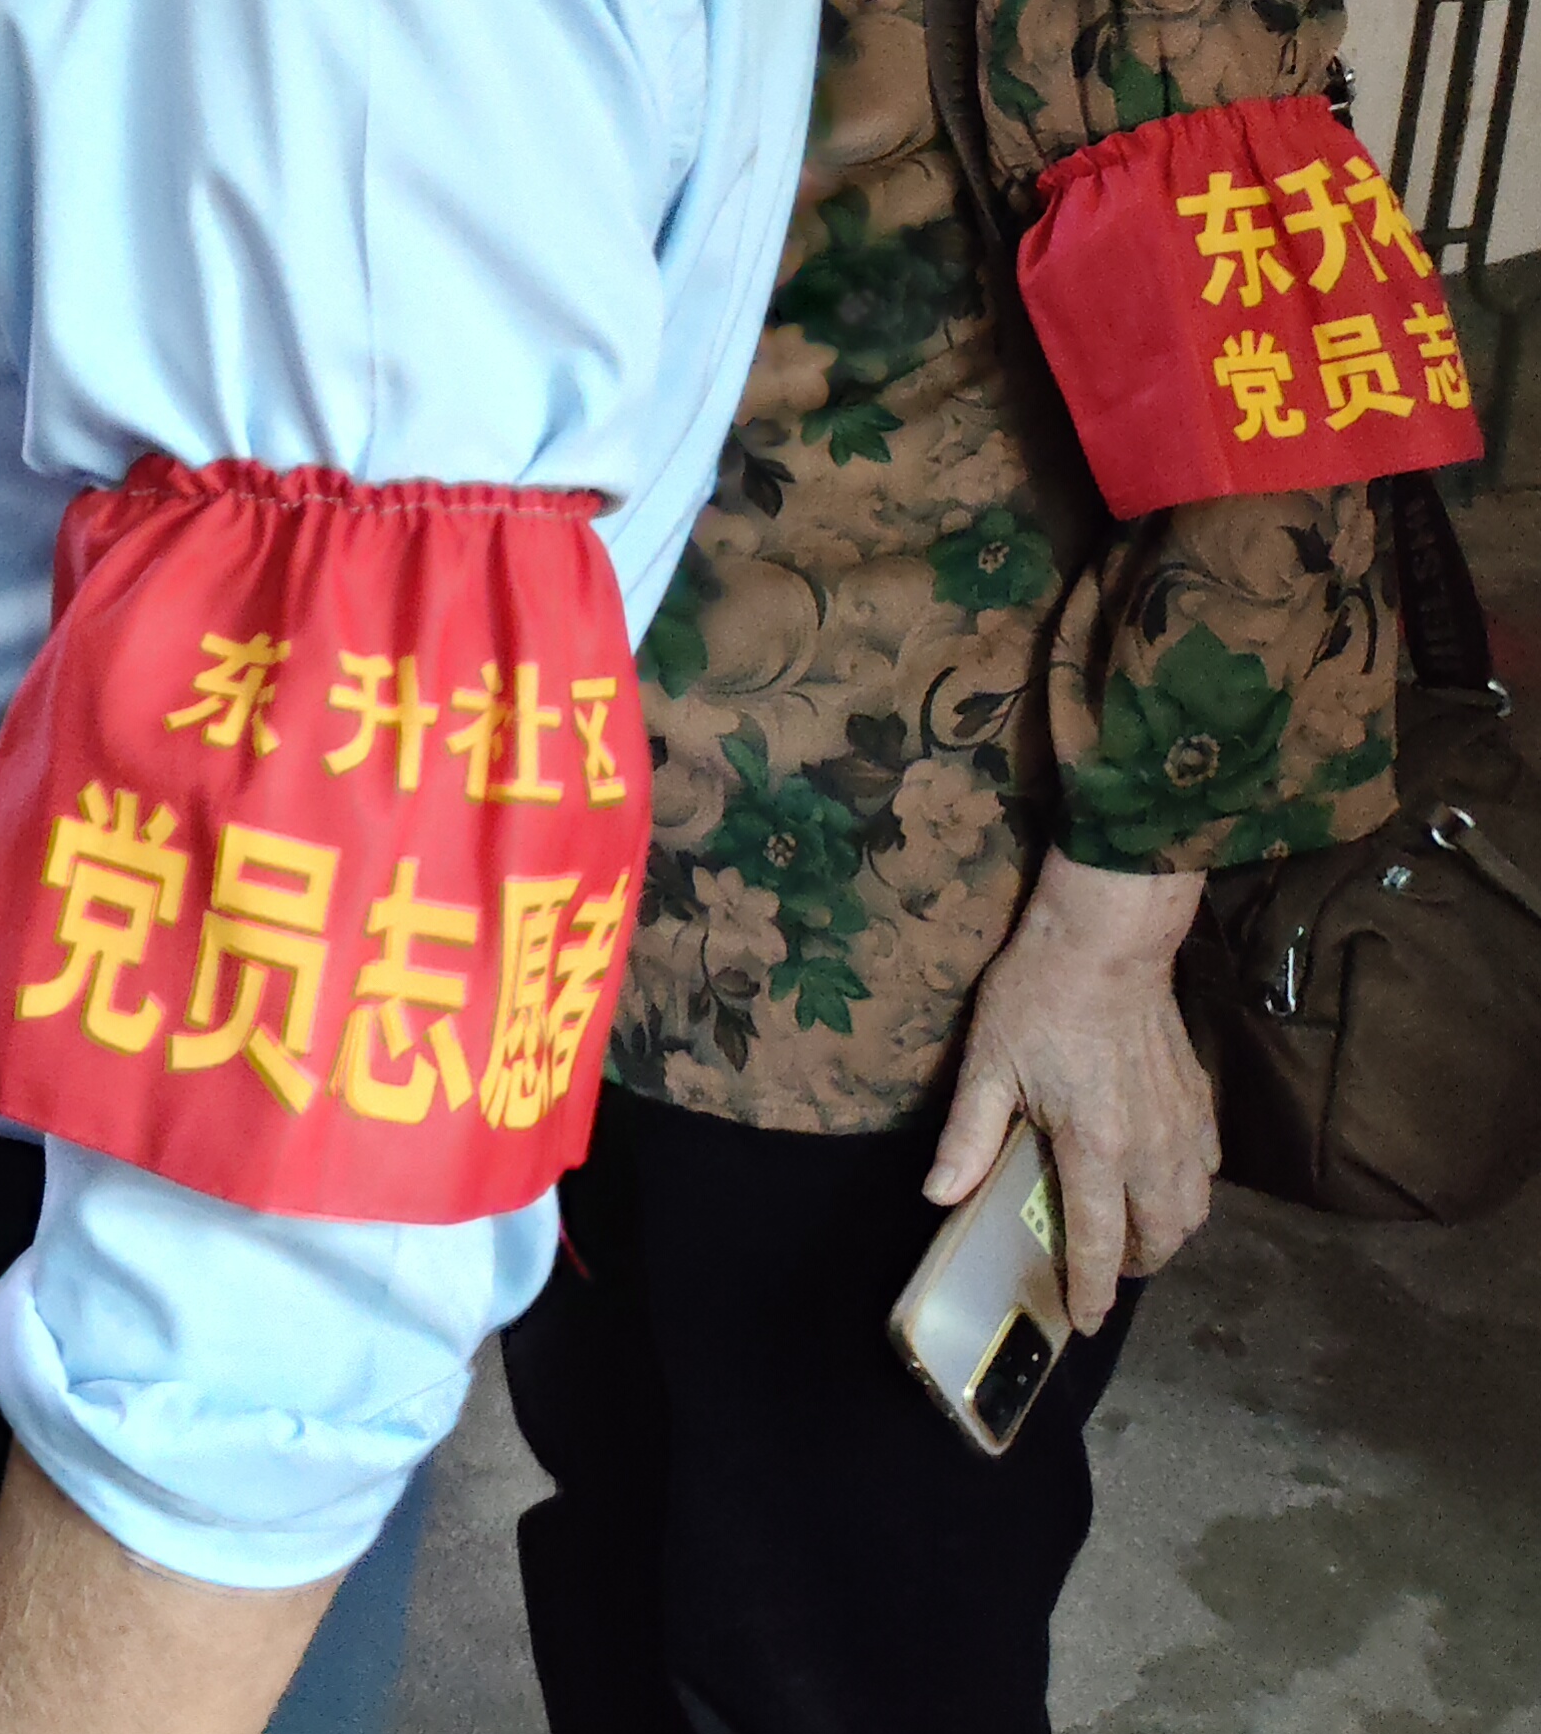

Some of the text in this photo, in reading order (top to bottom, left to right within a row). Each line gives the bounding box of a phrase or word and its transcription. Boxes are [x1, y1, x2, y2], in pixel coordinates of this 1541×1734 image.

[1213, 302, 1471, 442] 党员志
[163, 632, 627, 808] 东升社区
[17, 780, 632, 1130] 党员志愿者
